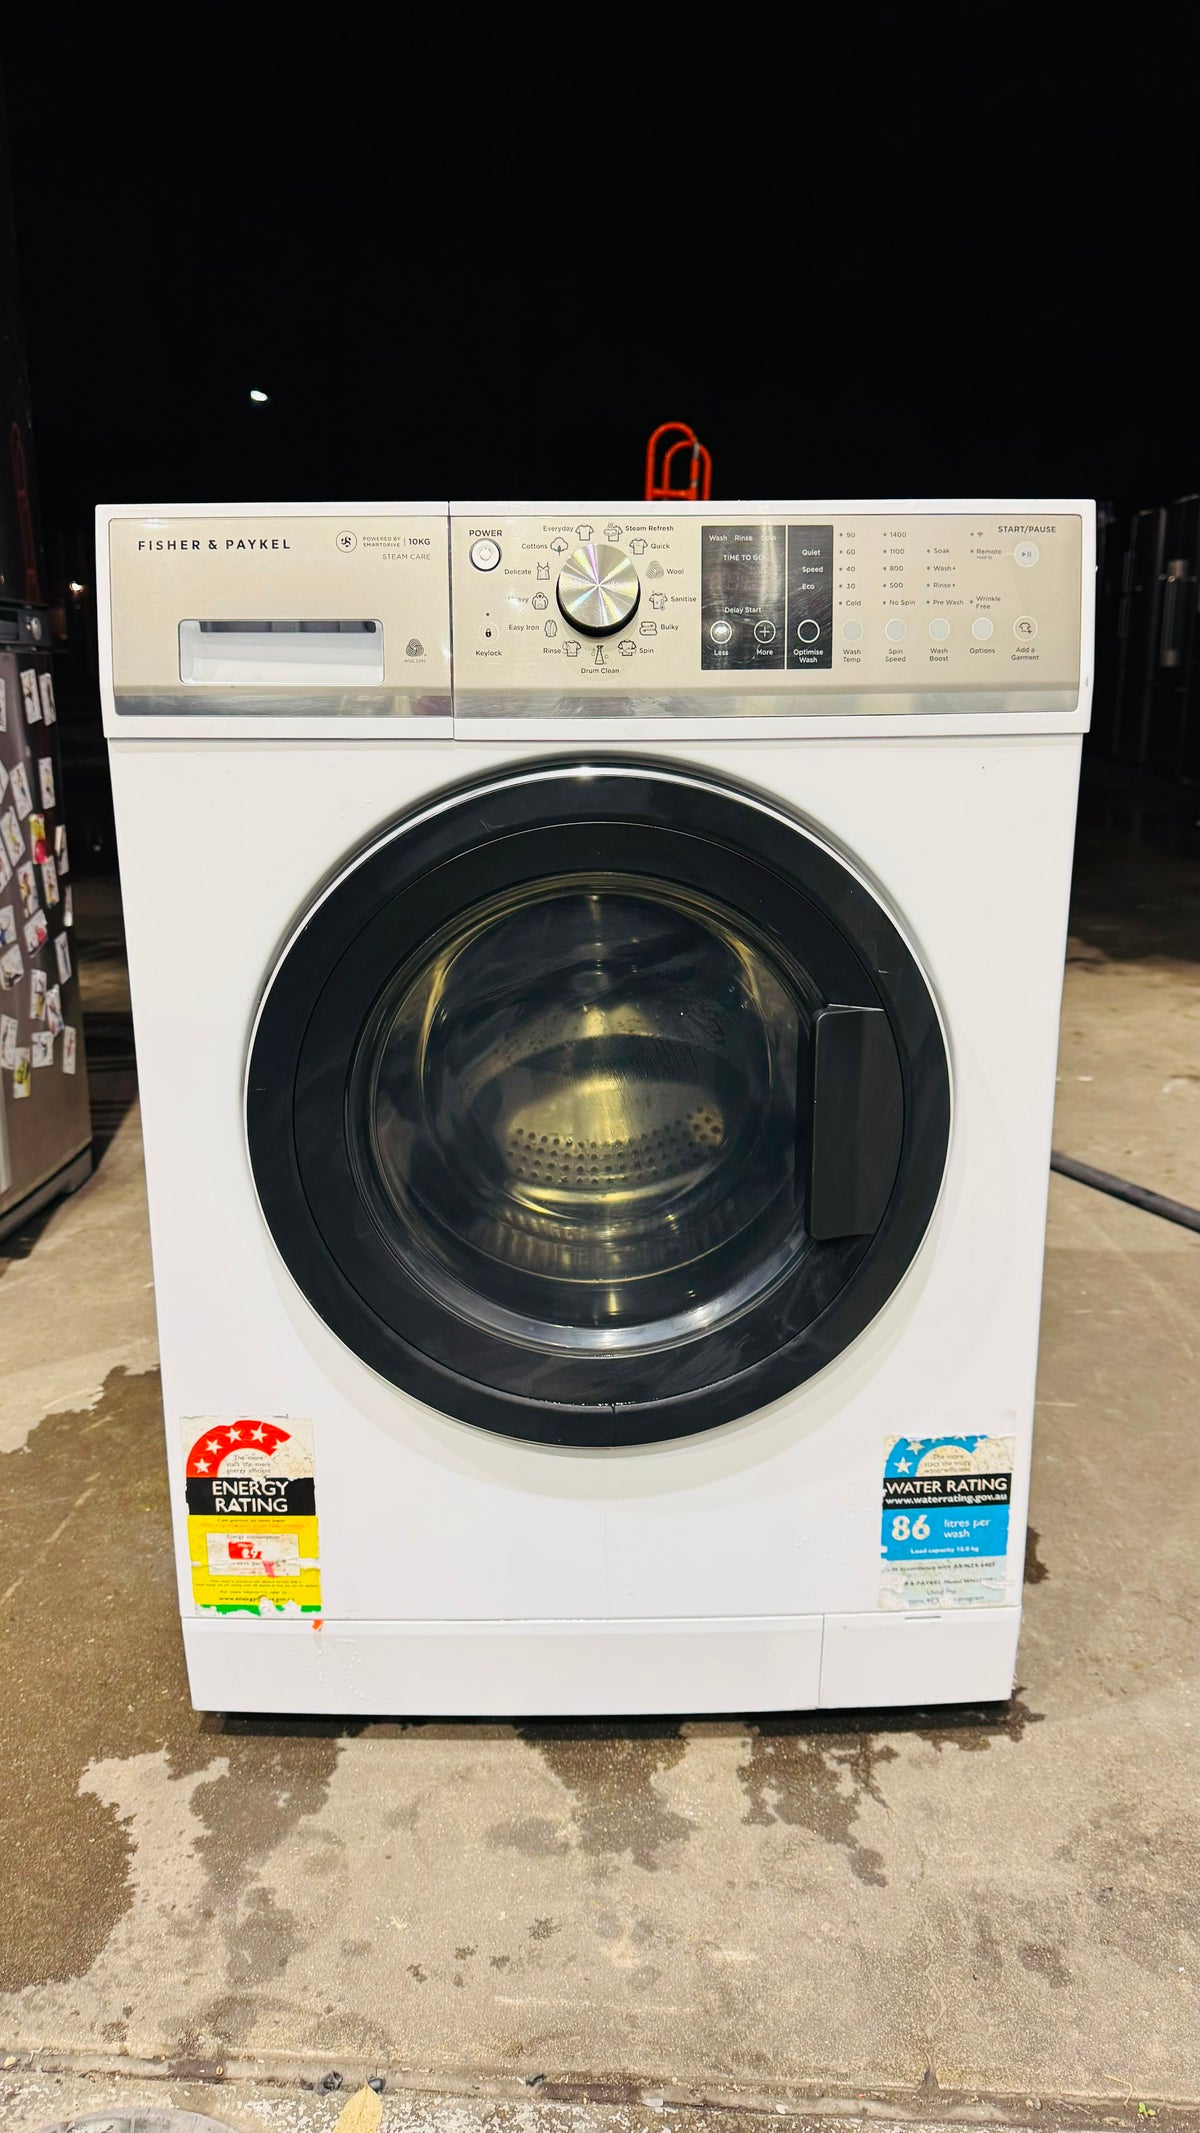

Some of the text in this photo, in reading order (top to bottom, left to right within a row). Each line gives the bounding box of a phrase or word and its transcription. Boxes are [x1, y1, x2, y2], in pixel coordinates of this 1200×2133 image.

[998, 526, 1056, 534] START/PAUSE
[138, 539, 290, 550] FISHER & PAYKEL
[802, 566, 823, 574] Speed
[212, 1480, 289, 1496] ENERGY
[886, 1478, 1008, 1494] WATER RATING
[886, 1494, 1008, 1504] www.waterrating.gov.au
[216, 1498, 288, 1513] RATING
[892, 1514, 930, 1541] 86
[944, 1519, 991, 1529] litres per
[944, 1529, 970, 1538] wash
